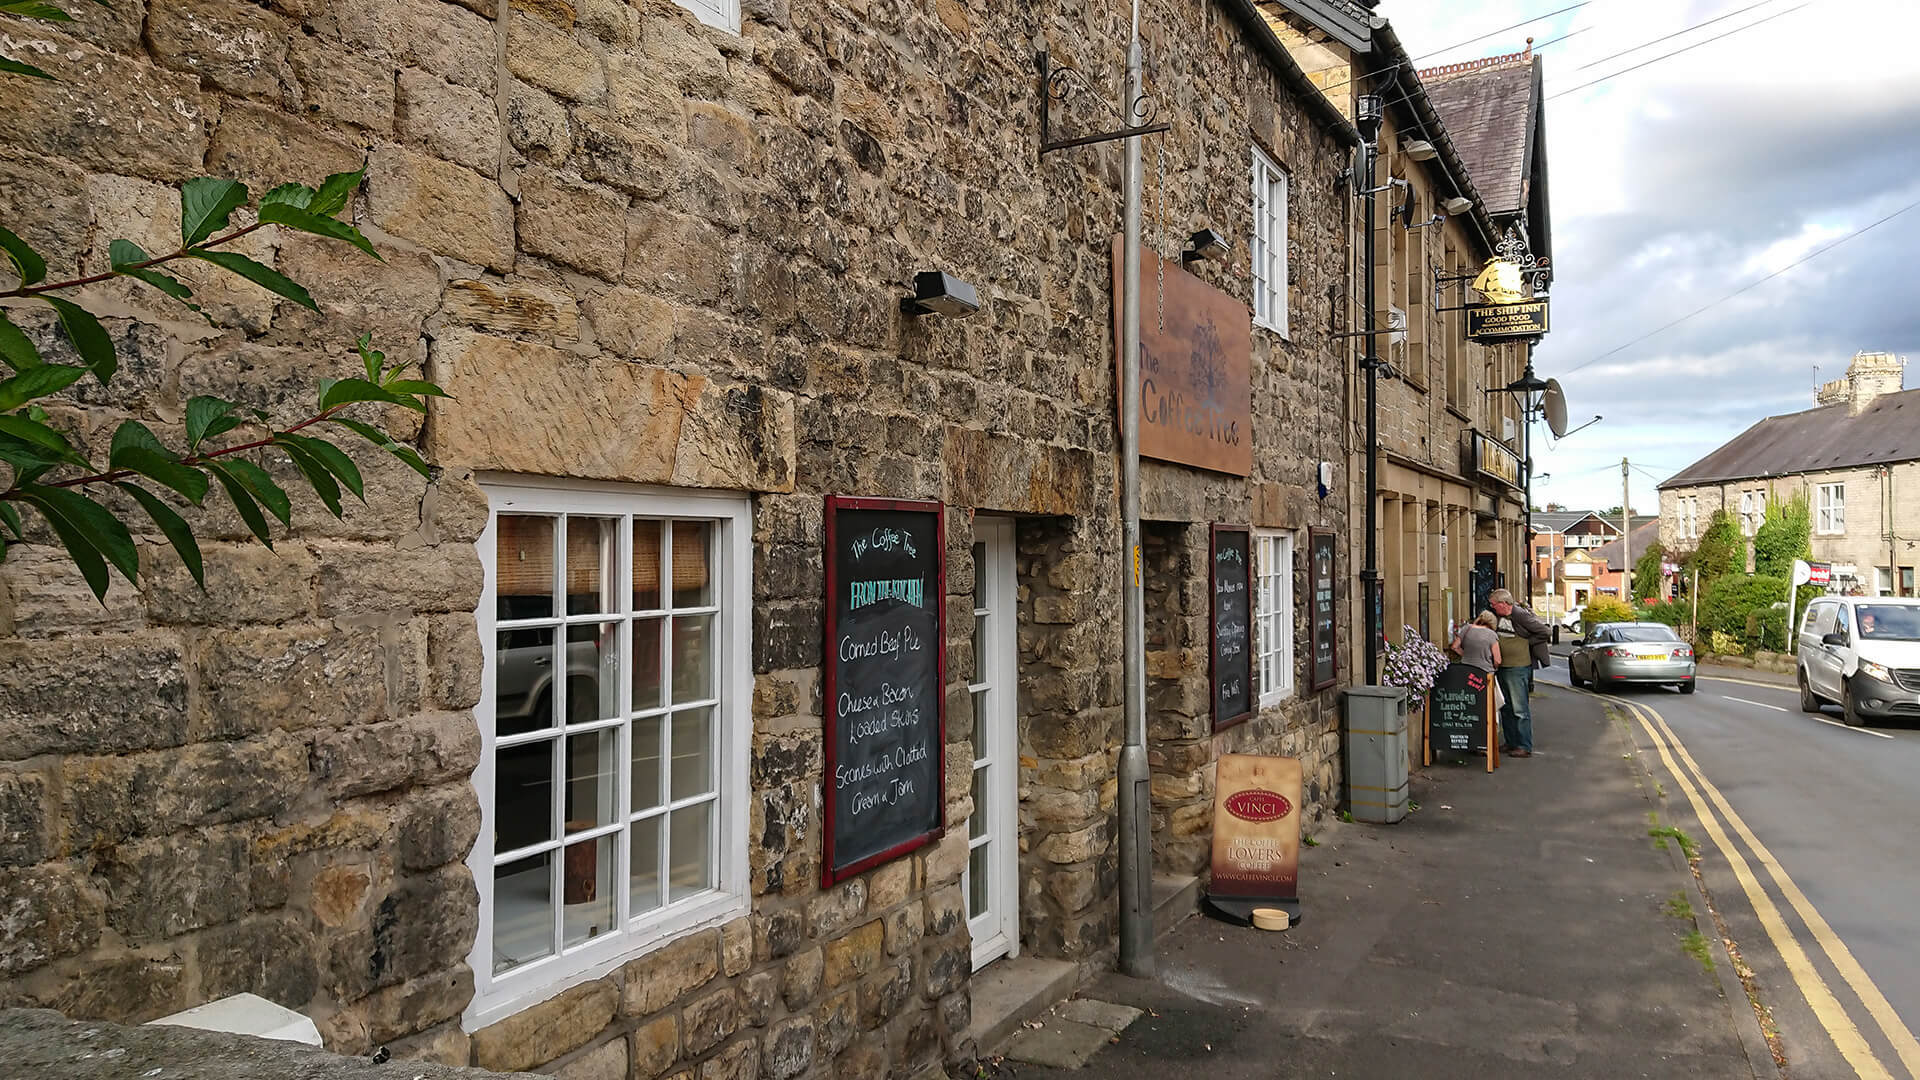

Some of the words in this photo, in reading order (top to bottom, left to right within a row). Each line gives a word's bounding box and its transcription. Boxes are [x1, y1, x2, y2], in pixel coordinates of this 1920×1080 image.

[1475, 308, 1494, 317] THE
[1496, 306, 1520, 315] SHIP
[1522, 304, 1541, 313] INN
[1476, 325, 1540, 334] ACCOMMODATION
[1139, 341, 1159, 373] The
[1141, 379, 1203, 436] Coffee
[1202, 399, 1240, 447] Tree
[850, 538, 868, 560] The
[871, 527, 900, 552] Coffee
[903, 530, 918, 559] Tree
[1812, 570, 1830, 579] sold
[850, 581, 876, 611] FROM
[839, 635, 878, 663] Corned
[879, 630, 901, 661] Beef
[904, 625, 921, 653] Pie
[838, 692, 873, 718] Cheese
[881, 682, 914, 706] Bacon
[1436, 687, 1477, 705] Sunday
[1440, 702, 1467, 711] Lunch
[850, 712, 887, 744] Loaded
[891, 708, 920, 729] Skins
[835, 764, 872, 790] Scones
[872, 754, 893, 777] with
[895, 739, 927, 769] Clotted
[852, 791, 880, 815] Cream
[890, 778, 915, 806] Jam
[1237, 802, 1276, 814] VINCI
[1229, 848, 1282, 861] LOVERS
[1233, 838, 1248, 847] THE
[1250, 839, 1280, 848] COFFEE
